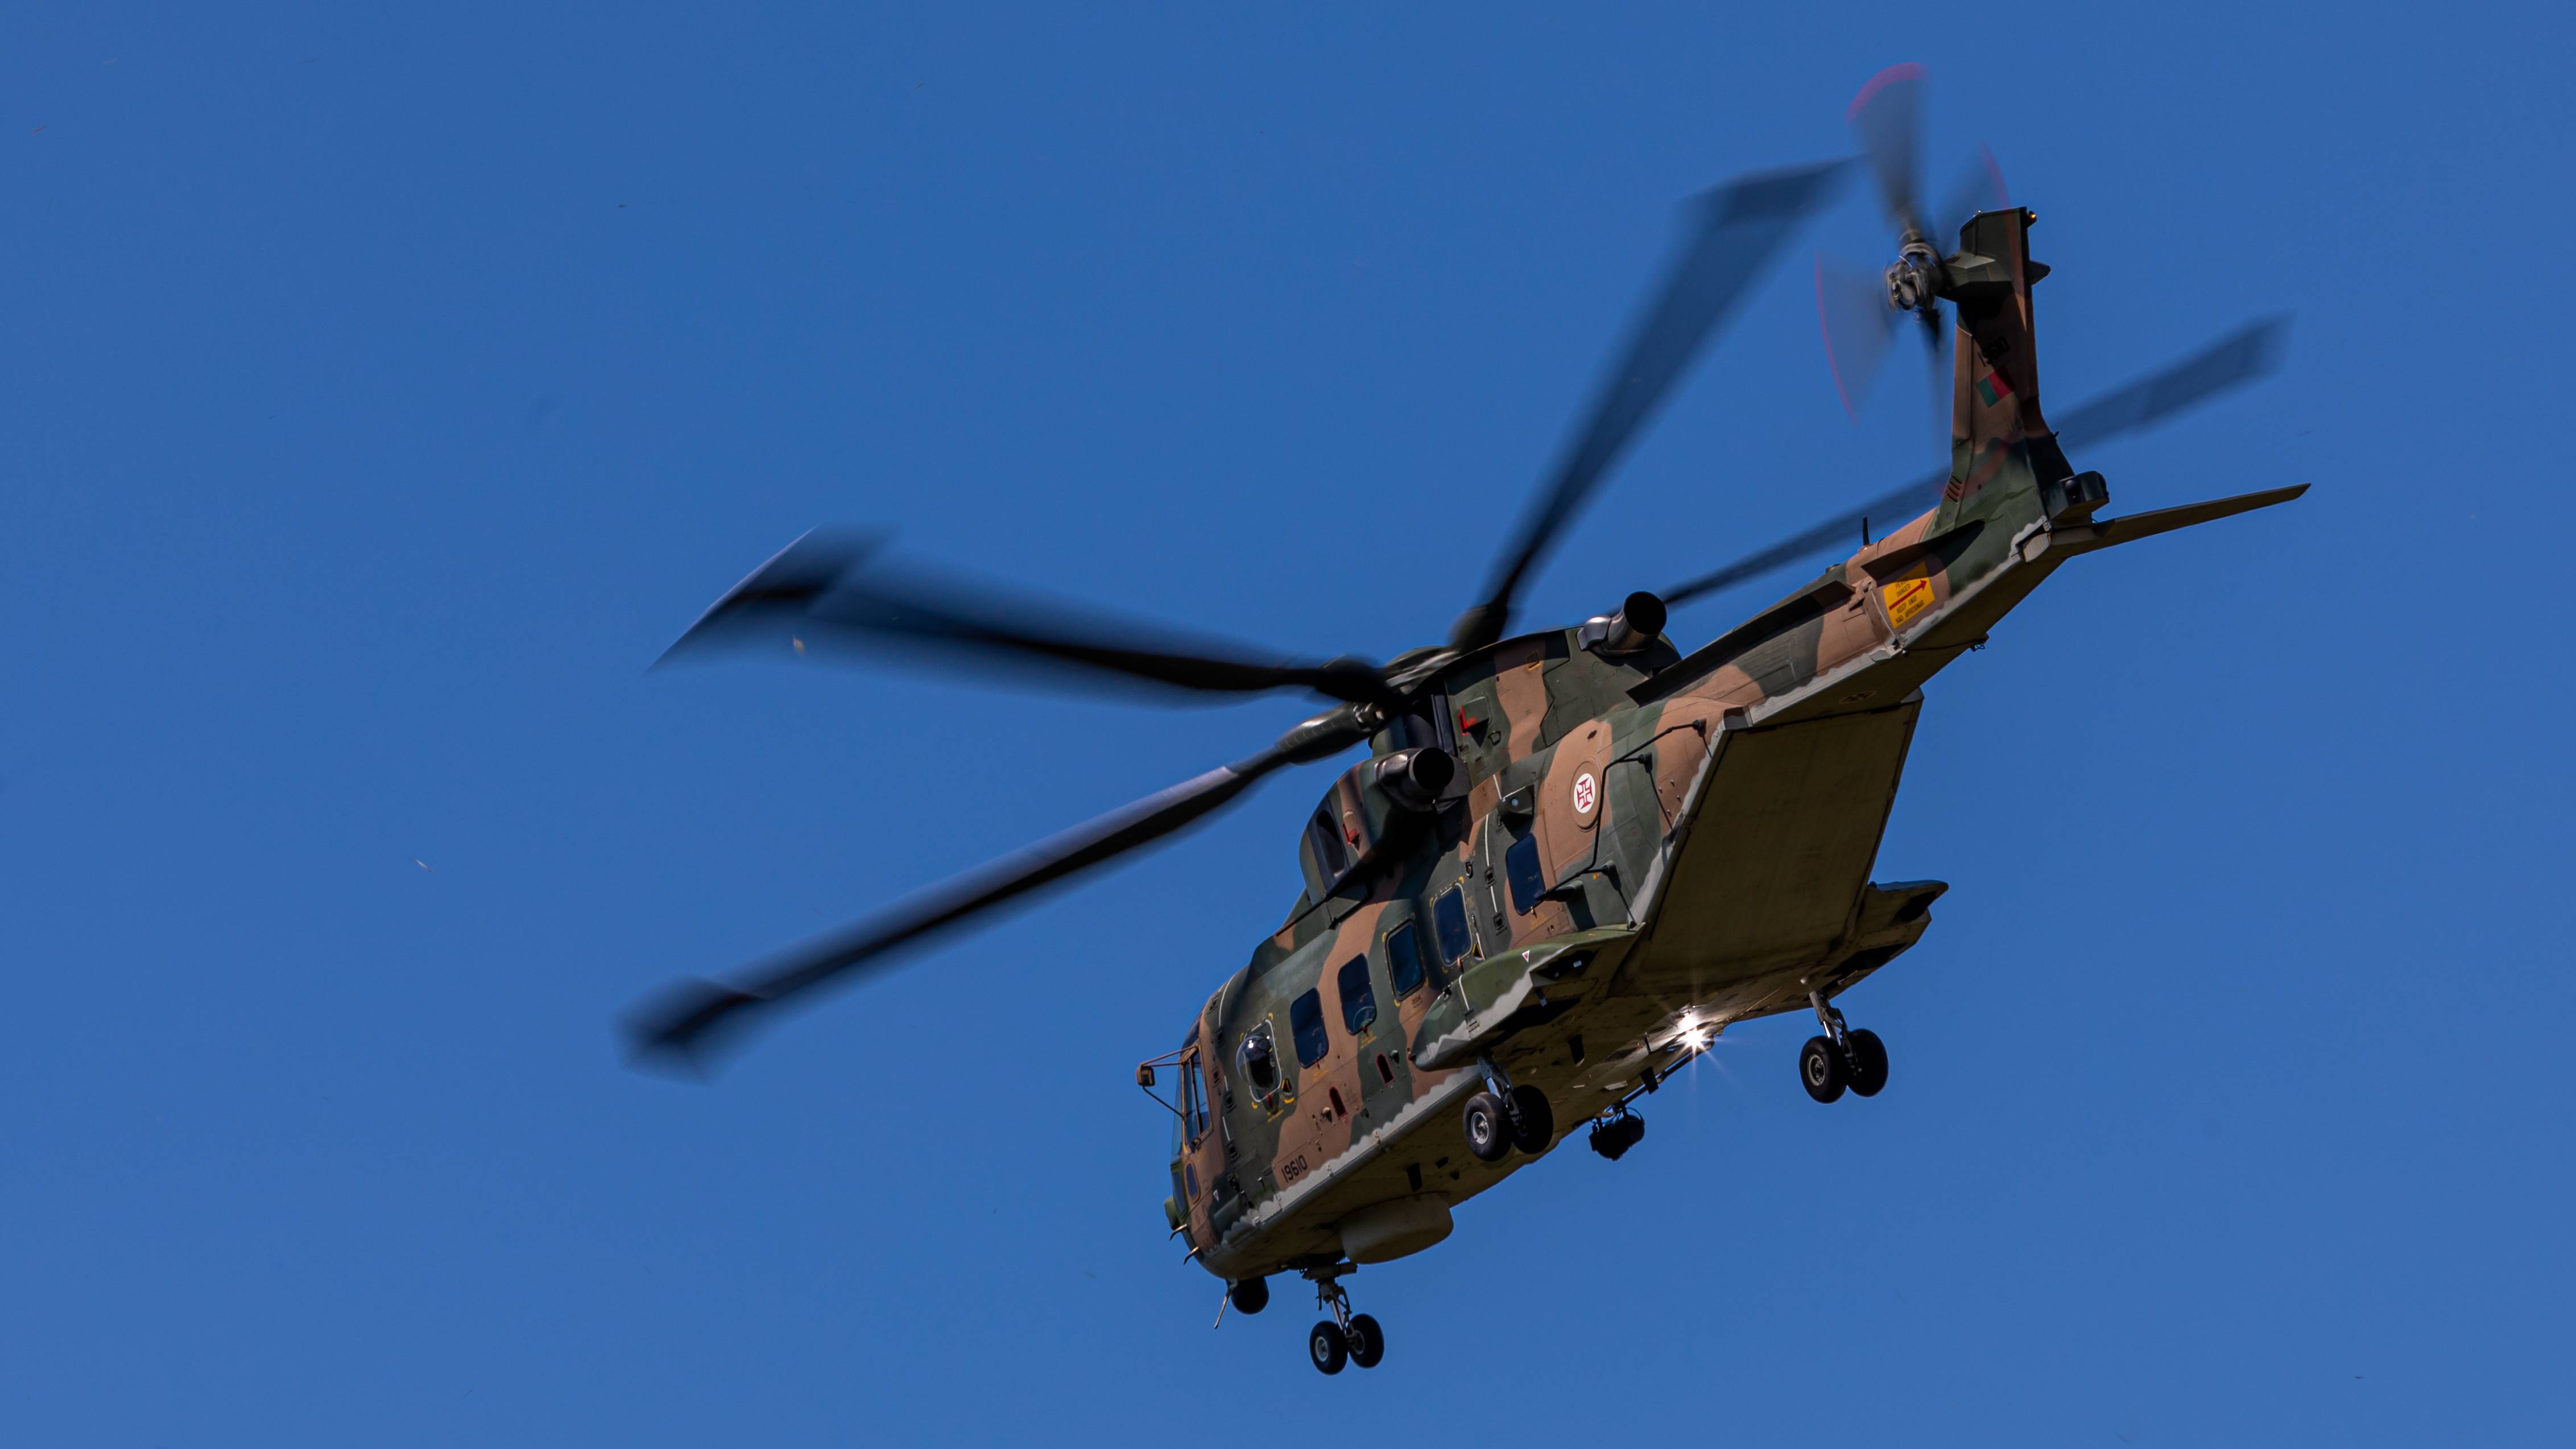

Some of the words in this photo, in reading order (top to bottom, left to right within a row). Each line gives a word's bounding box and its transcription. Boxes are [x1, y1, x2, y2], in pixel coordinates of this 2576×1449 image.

[1978, 336, 2009, 367] 19610
[1897, 603, 1907, 614] KEEP
[1281, 1154, 1308, 1183] 19610
